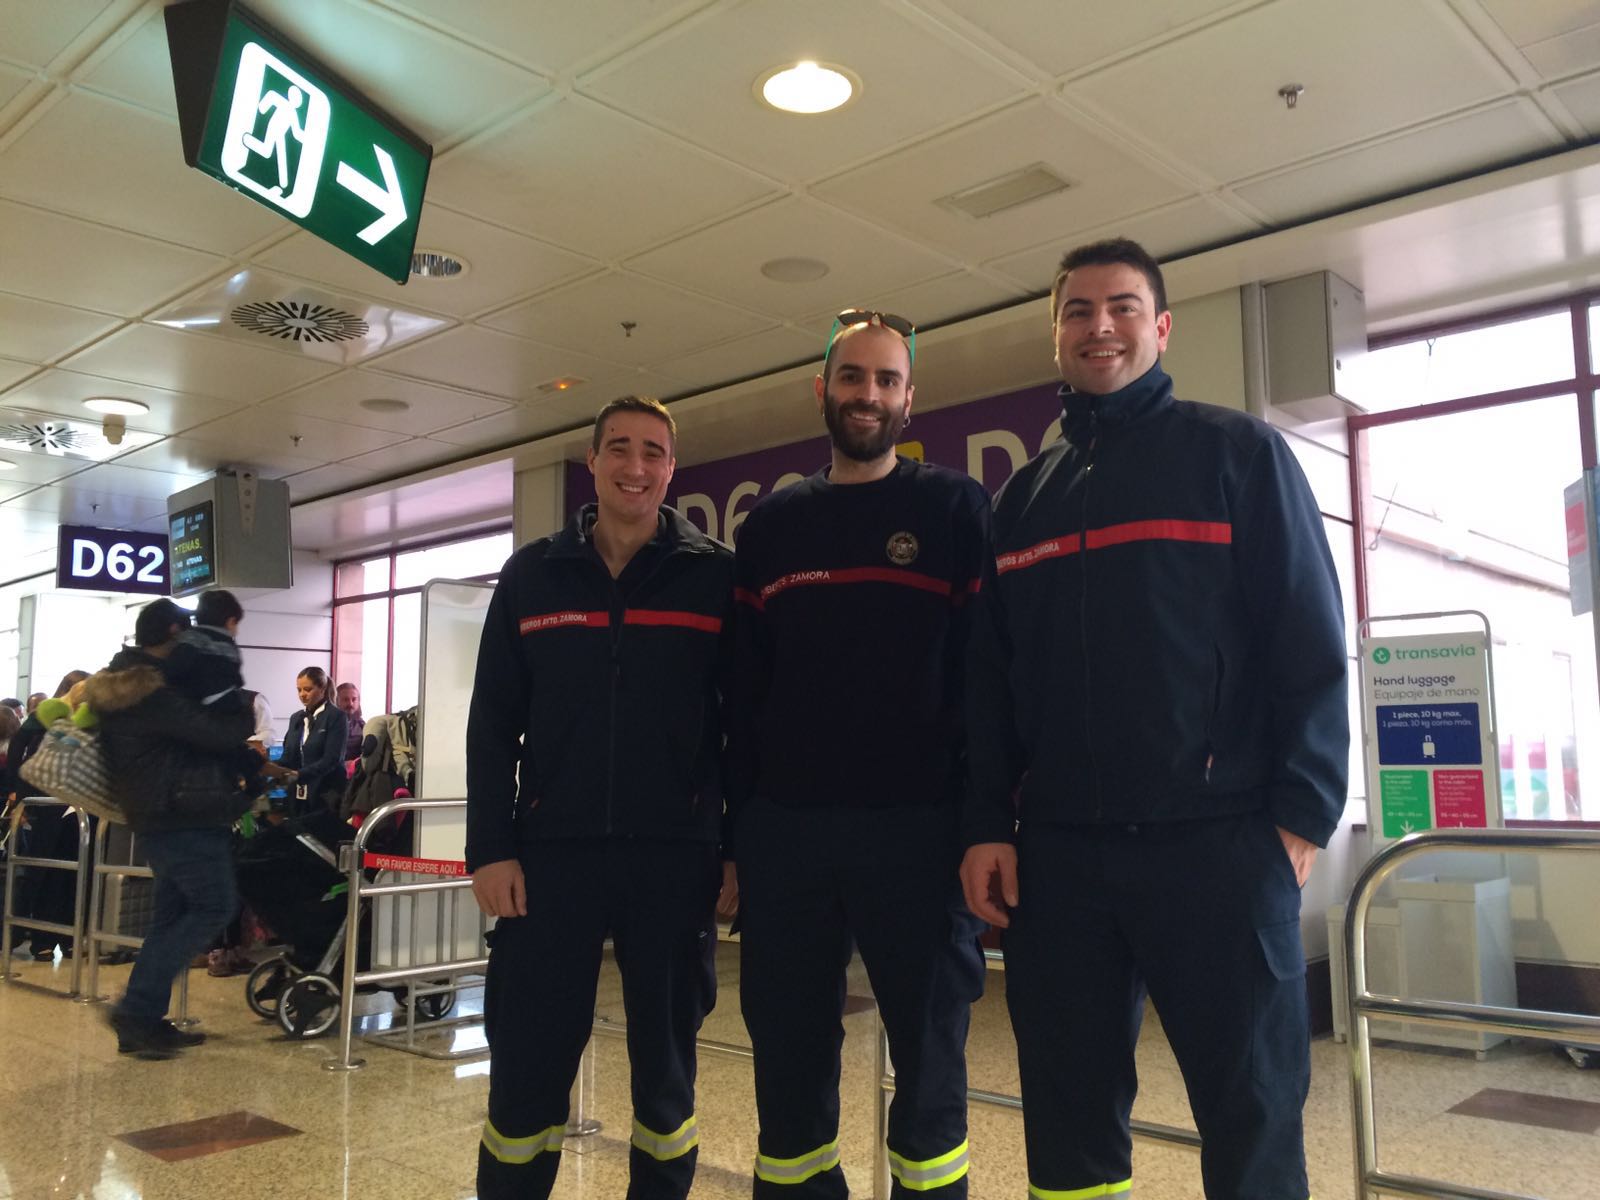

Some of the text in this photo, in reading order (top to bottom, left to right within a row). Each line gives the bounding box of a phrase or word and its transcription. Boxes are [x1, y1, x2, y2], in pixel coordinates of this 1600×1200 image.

[677, 472, 806, 551] D6
[72, 539, 164, 583] D62
[790, 570, 831, 583] ZAMORA
[560, 613, 587, 622] ZAMORA
[1395, 644, 1476, 660] transavia
[1373, 675, 1456, 687] Hand luggage
[1374, 687, 1480, 701] Equipaje de mano
[1421, 710, 1431, 718] 10
[1432, 710, 1442, 719] kg
[376, 858, 390, 868] POR
[391, 859, 412, 871] FAVOR
[413, 861, 439, 874] ESPERE
